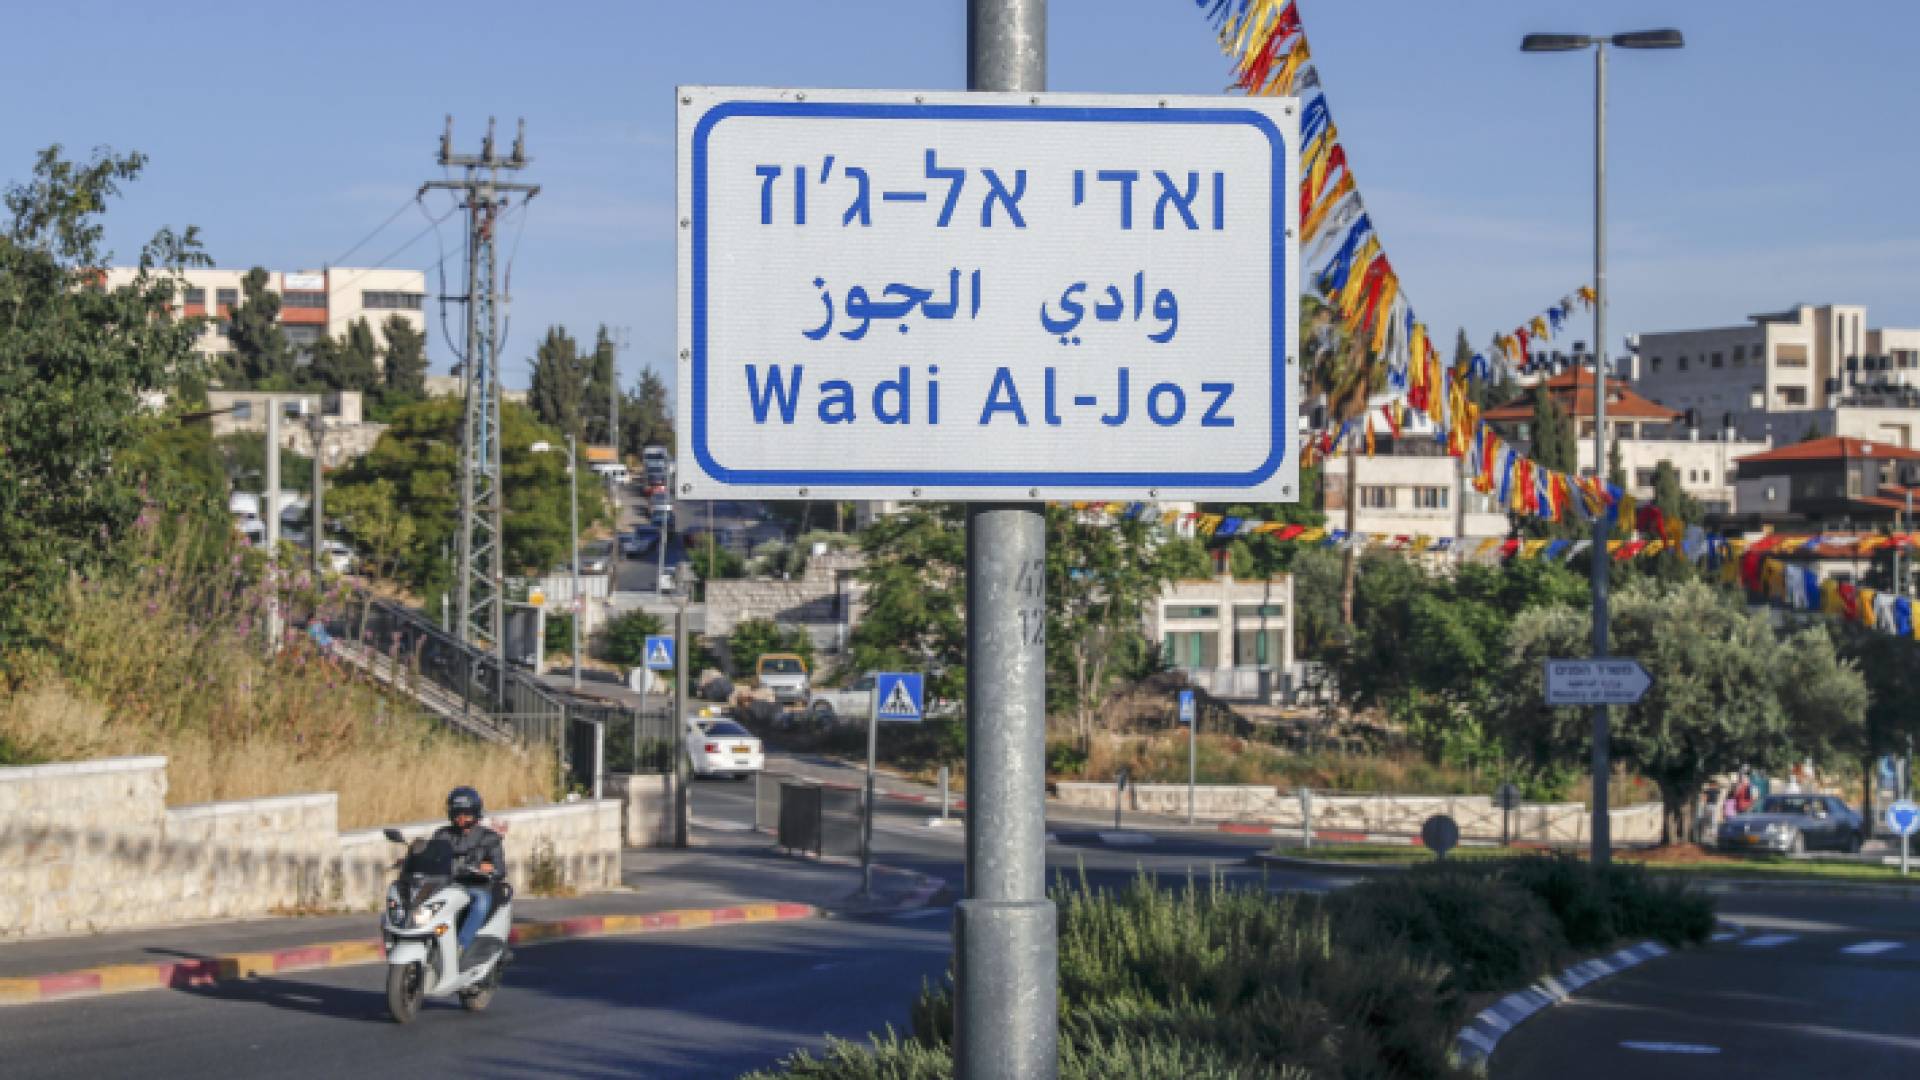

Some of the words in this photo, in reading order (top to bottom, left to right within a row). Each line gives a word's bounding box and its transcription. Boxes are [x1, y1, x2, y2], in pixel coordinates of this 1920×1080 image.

[1072, 169, 1225, 230] ואדי
[802, 267, 982, 342] الجوز
[1039, 270, 1179, 346] وادي
[744, 363, 941, 426] Wadi
[978, 366, 1236, 428] Al-Joz
